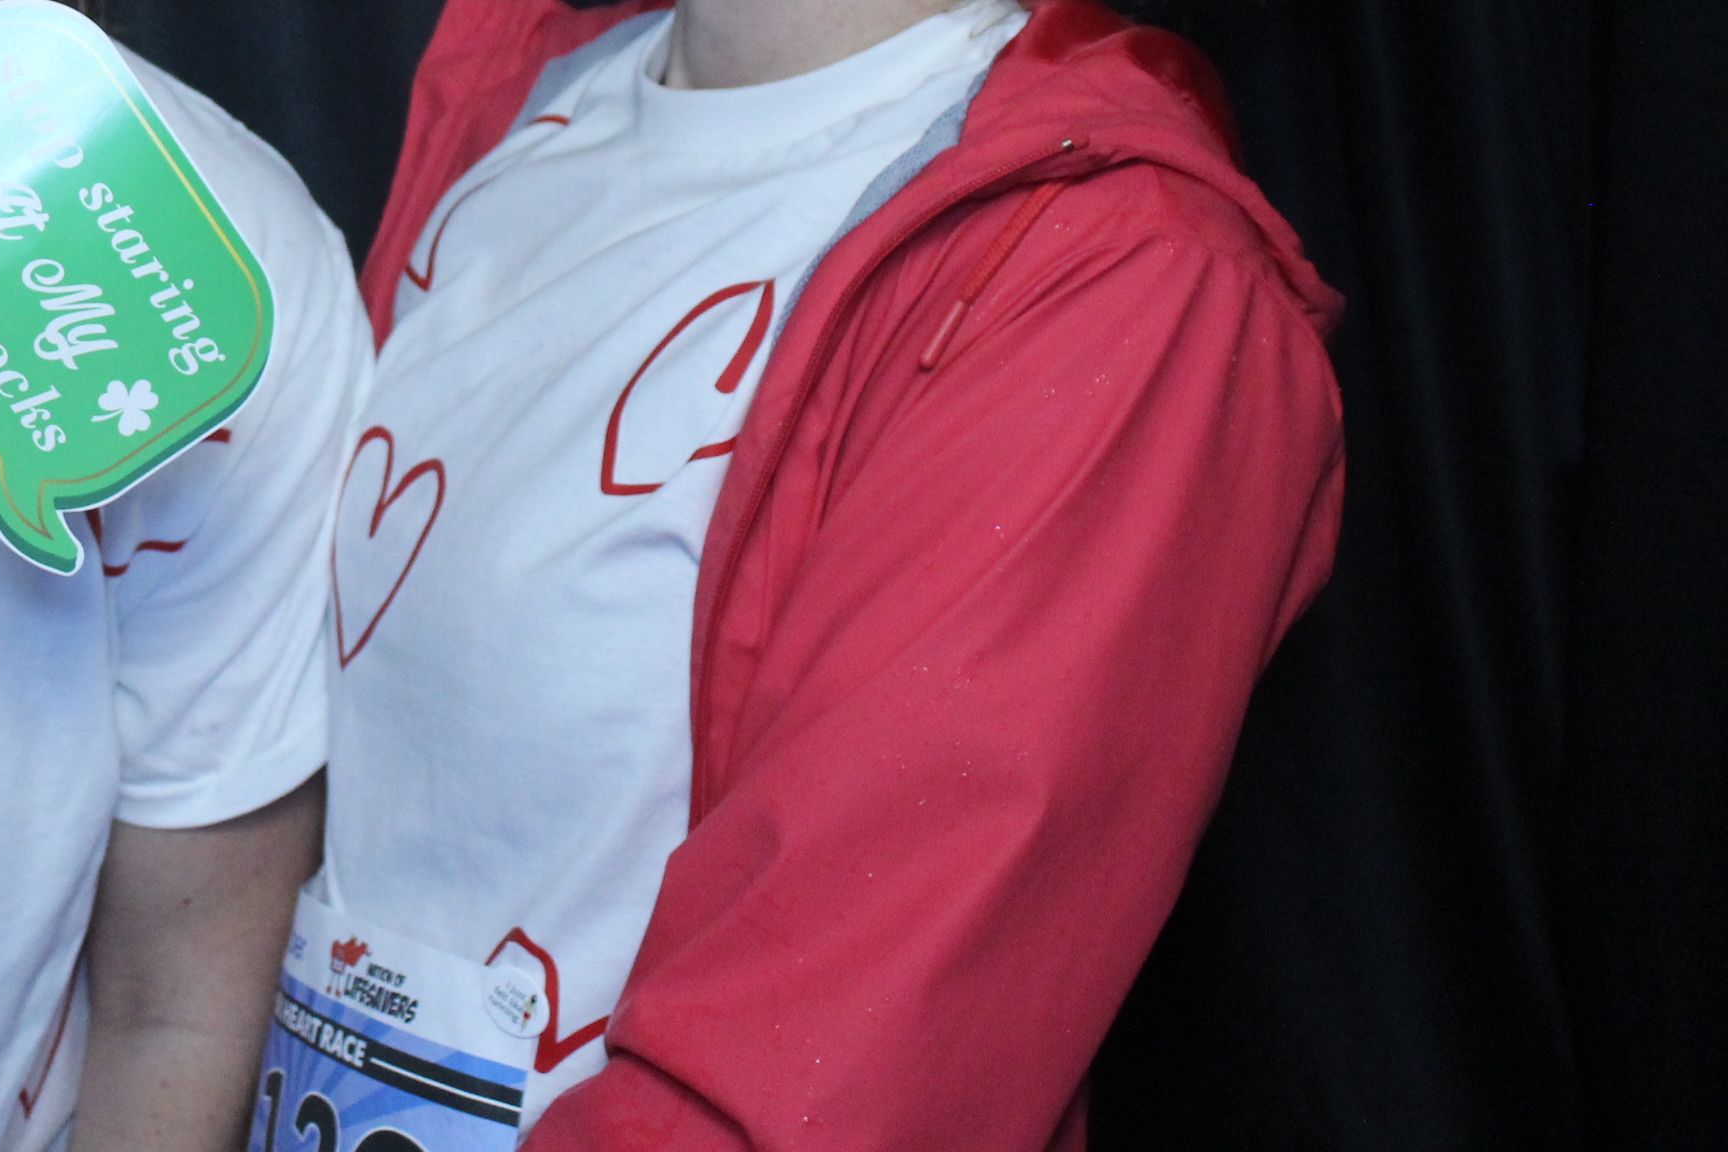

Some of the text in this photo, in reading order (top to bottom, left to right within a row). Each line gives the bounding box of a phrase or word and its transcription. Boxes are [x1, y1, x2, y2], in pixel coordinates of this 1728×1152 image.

[20, 258, 119, 371] My
[78, 182, 226, 376] staring
[343, 972, 419, 1024] LIFESAVERS
[319, 1022, 368, 1069] RACE
